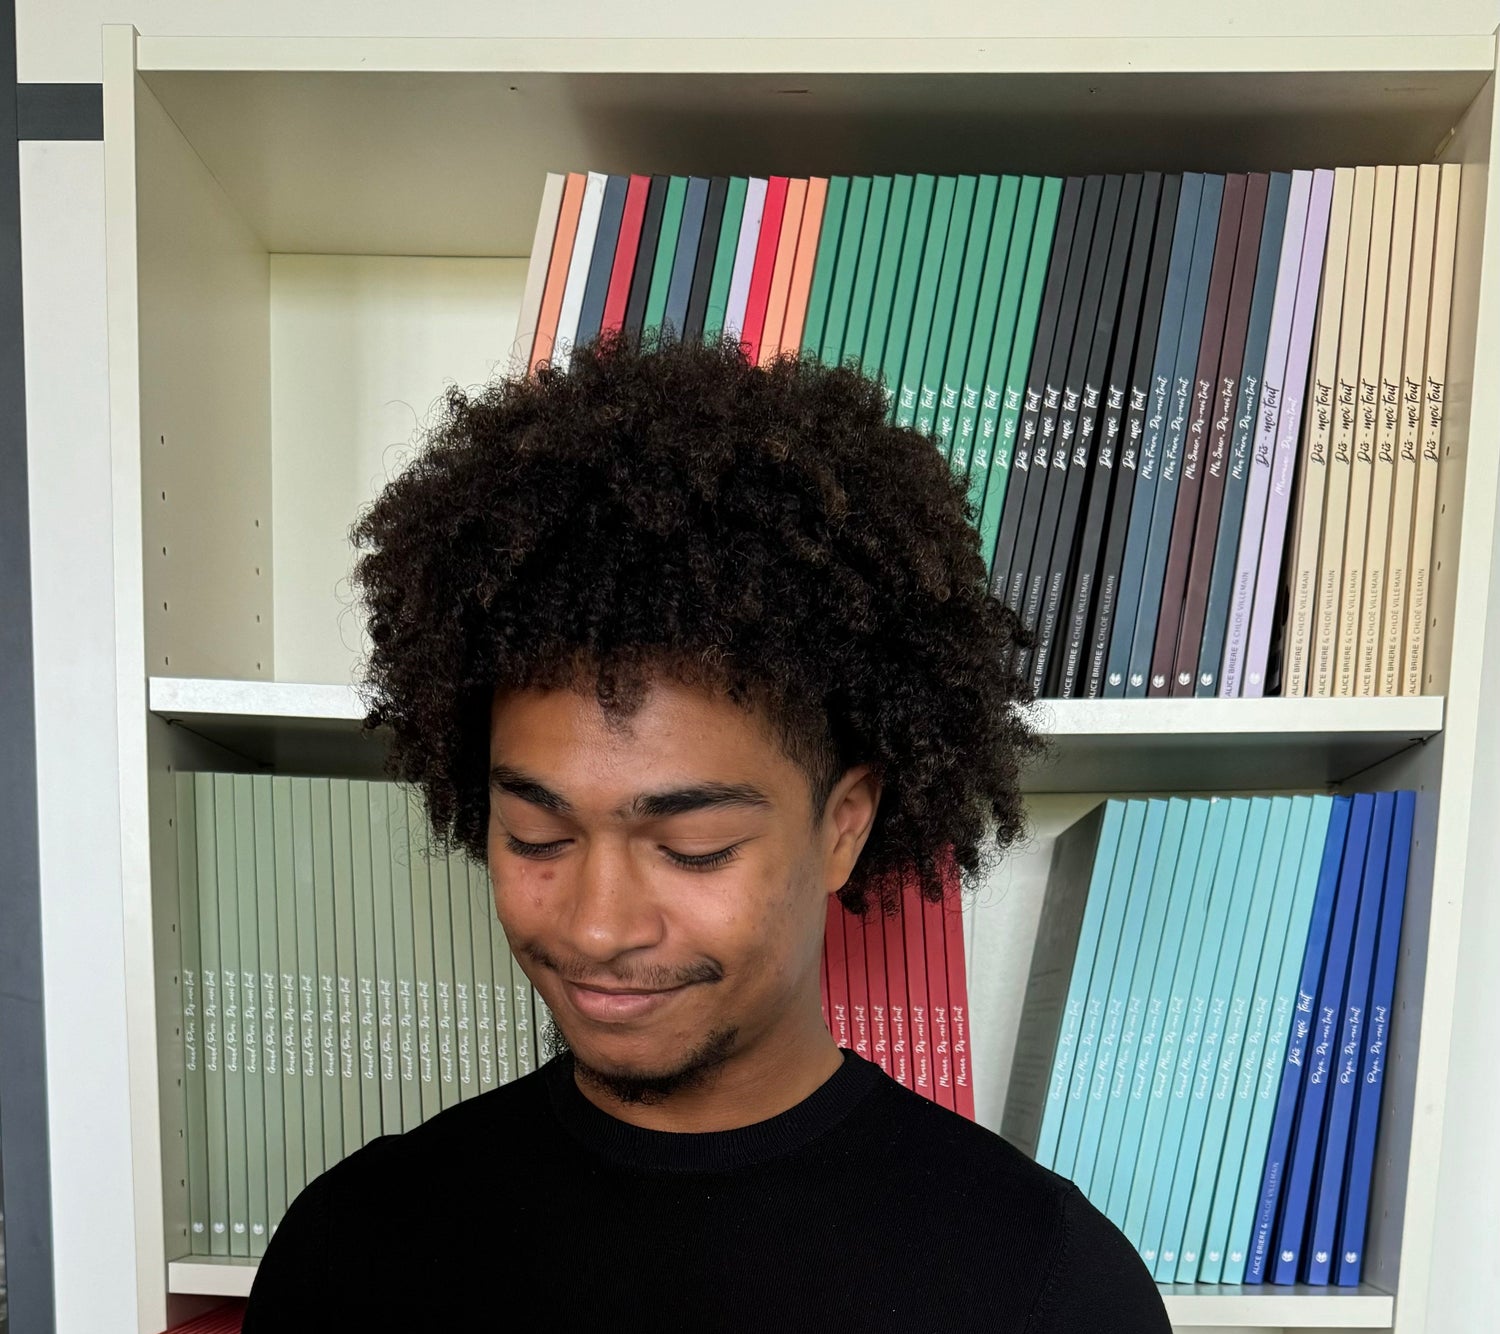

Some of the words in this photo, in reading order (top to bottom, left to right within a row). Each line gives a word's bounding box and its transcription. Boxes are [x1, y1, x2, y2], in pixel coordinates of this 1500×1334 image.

[983, 384, 1000, 410] tout
[1024, 386, 1042, 412] tout
[1043, 384, 1061, 409] tout
[1082, 383, 1100, 409] tout
[1107, 384, 1124, 409] tout
[1130, 386, 1147, 411] tout
[1262, 380, 1280, 409] tout
[1315, 379, 1332, 407] tout
[1338, 378, 1355, 406] tout
[1360, 378, 1377, 405] tout
[1381, 378, 1399, 405] tout
[1404, 376, 1421, 404] tout
[1426, 376, 1444, 403] tout
[1141, 459, 1155, 480] Mon
[1155, 375, 1168, 396] tout
[1163, 461, 1176, 481] Mon
[1176, 376, 1189, 397] tout
[1184, 462, 1196, 480] Ma
[1197, 379, 1210, 400] tout
[1209, 460, 1221, 477] Ma
[1222, 377, 1235, 397] tout
[1231, 460, 1244, 480] Mon
[1244, 375, 1257, 396] tout
[1063, 678, 1073, 697] ALICE
[1078, 574, 1090, 613] VILLEMAIN
[1224, 675, 1234, 697] ALICE
[1237, 572, 1249, 611] VILLEMAIN
[1291, 675, 1300, 696] ALICE
[1300, 570, 1310, 610] VILLEMAIN
[1385, 673, 1394, 695] ALICE
[1392, 569, 1402, 608] VILLEMAIN
[913, 1006, 925, 1023] tout
[953, 1006, 964, 1022] tout
[1296, 989, 1313, 1013] tout
[1374, 1006, 1386, 1023] tout
[934, 1007, 946, 1023] tout
[1321, 1006, 1334, 1024] tout
[1349, 1007, 1361, 1024] tout
[1252, 1256, 1262, 1275] ALICE
